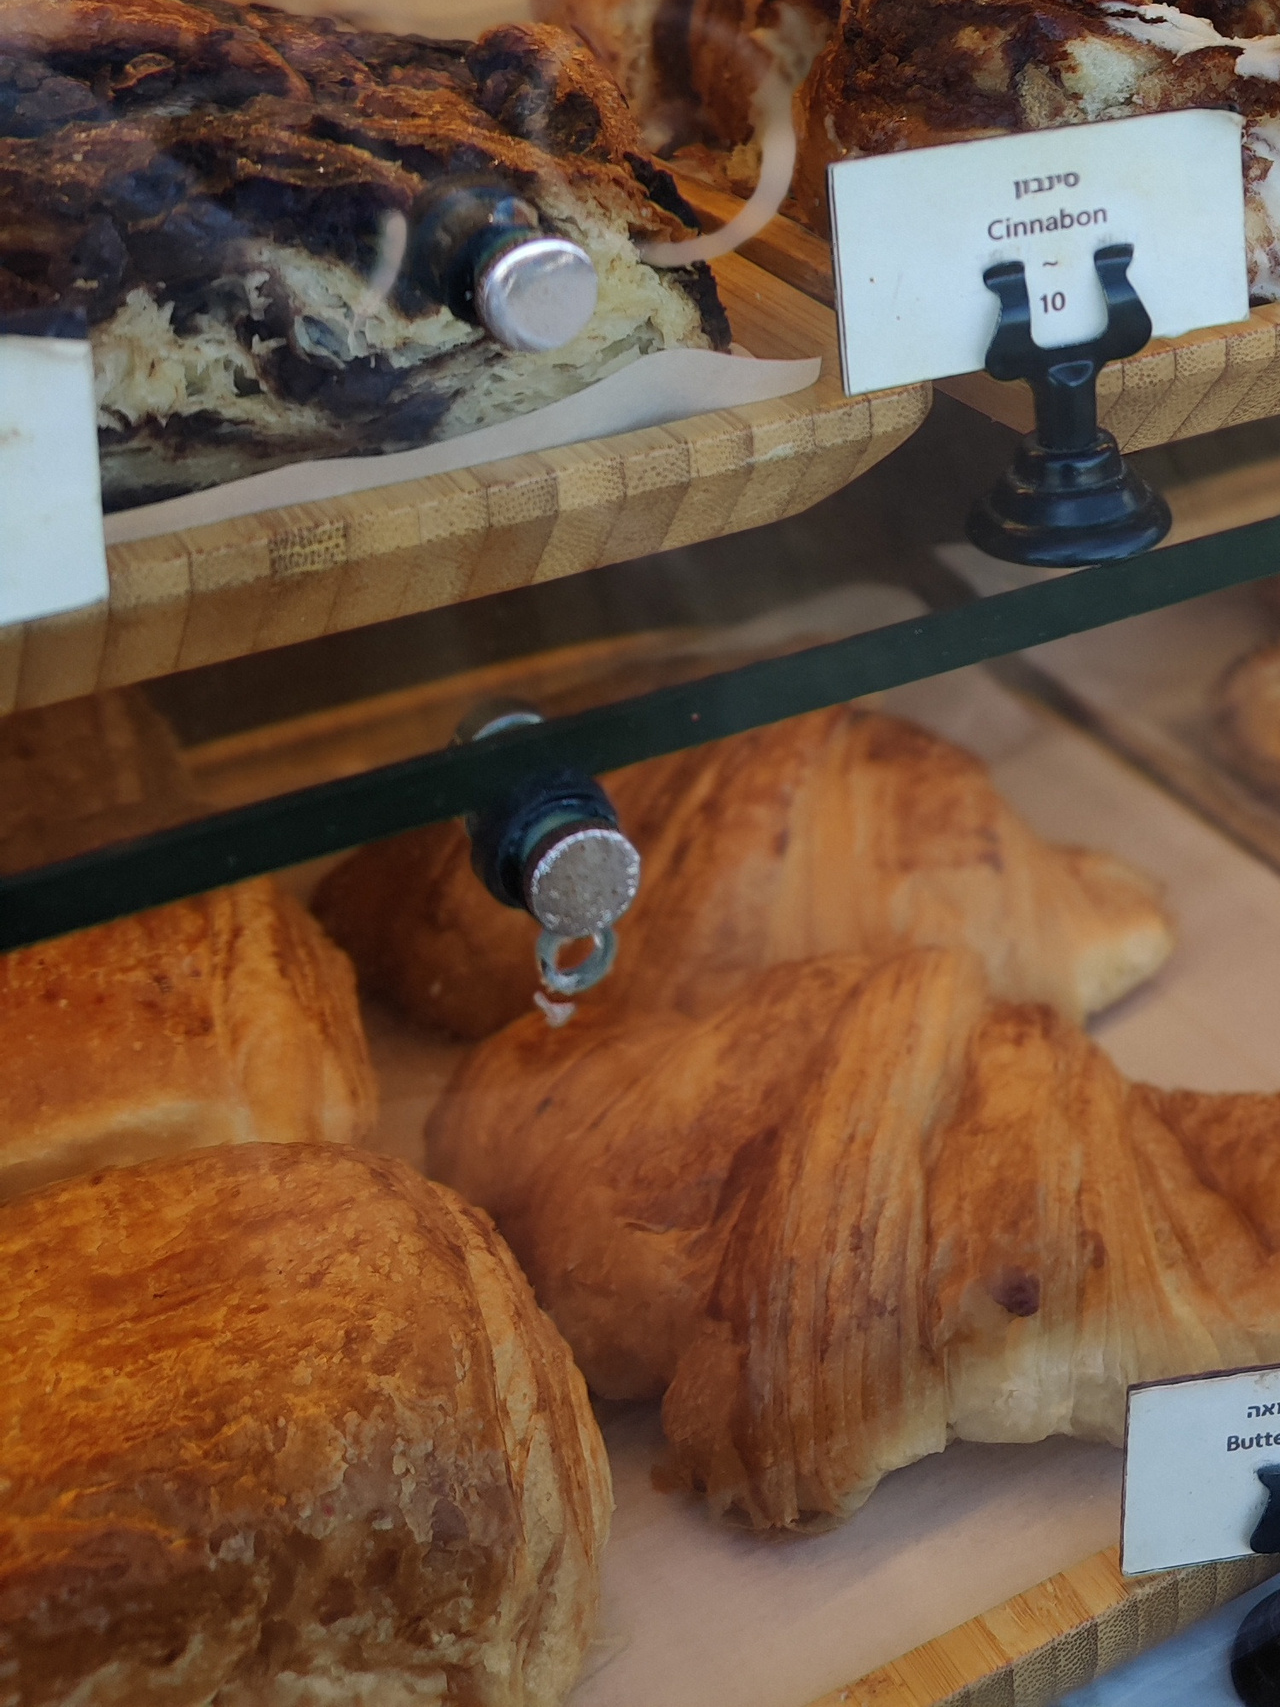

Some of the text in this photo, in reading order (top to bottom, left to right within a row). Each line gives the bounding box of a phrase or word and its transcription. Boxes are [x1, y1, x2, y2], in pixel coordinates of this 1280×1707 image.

[1013, 172, 1080, 199] סינבון
[987, 208, 1107, 241] Cinnabon
[1040, 291, 1067, 313] 10
